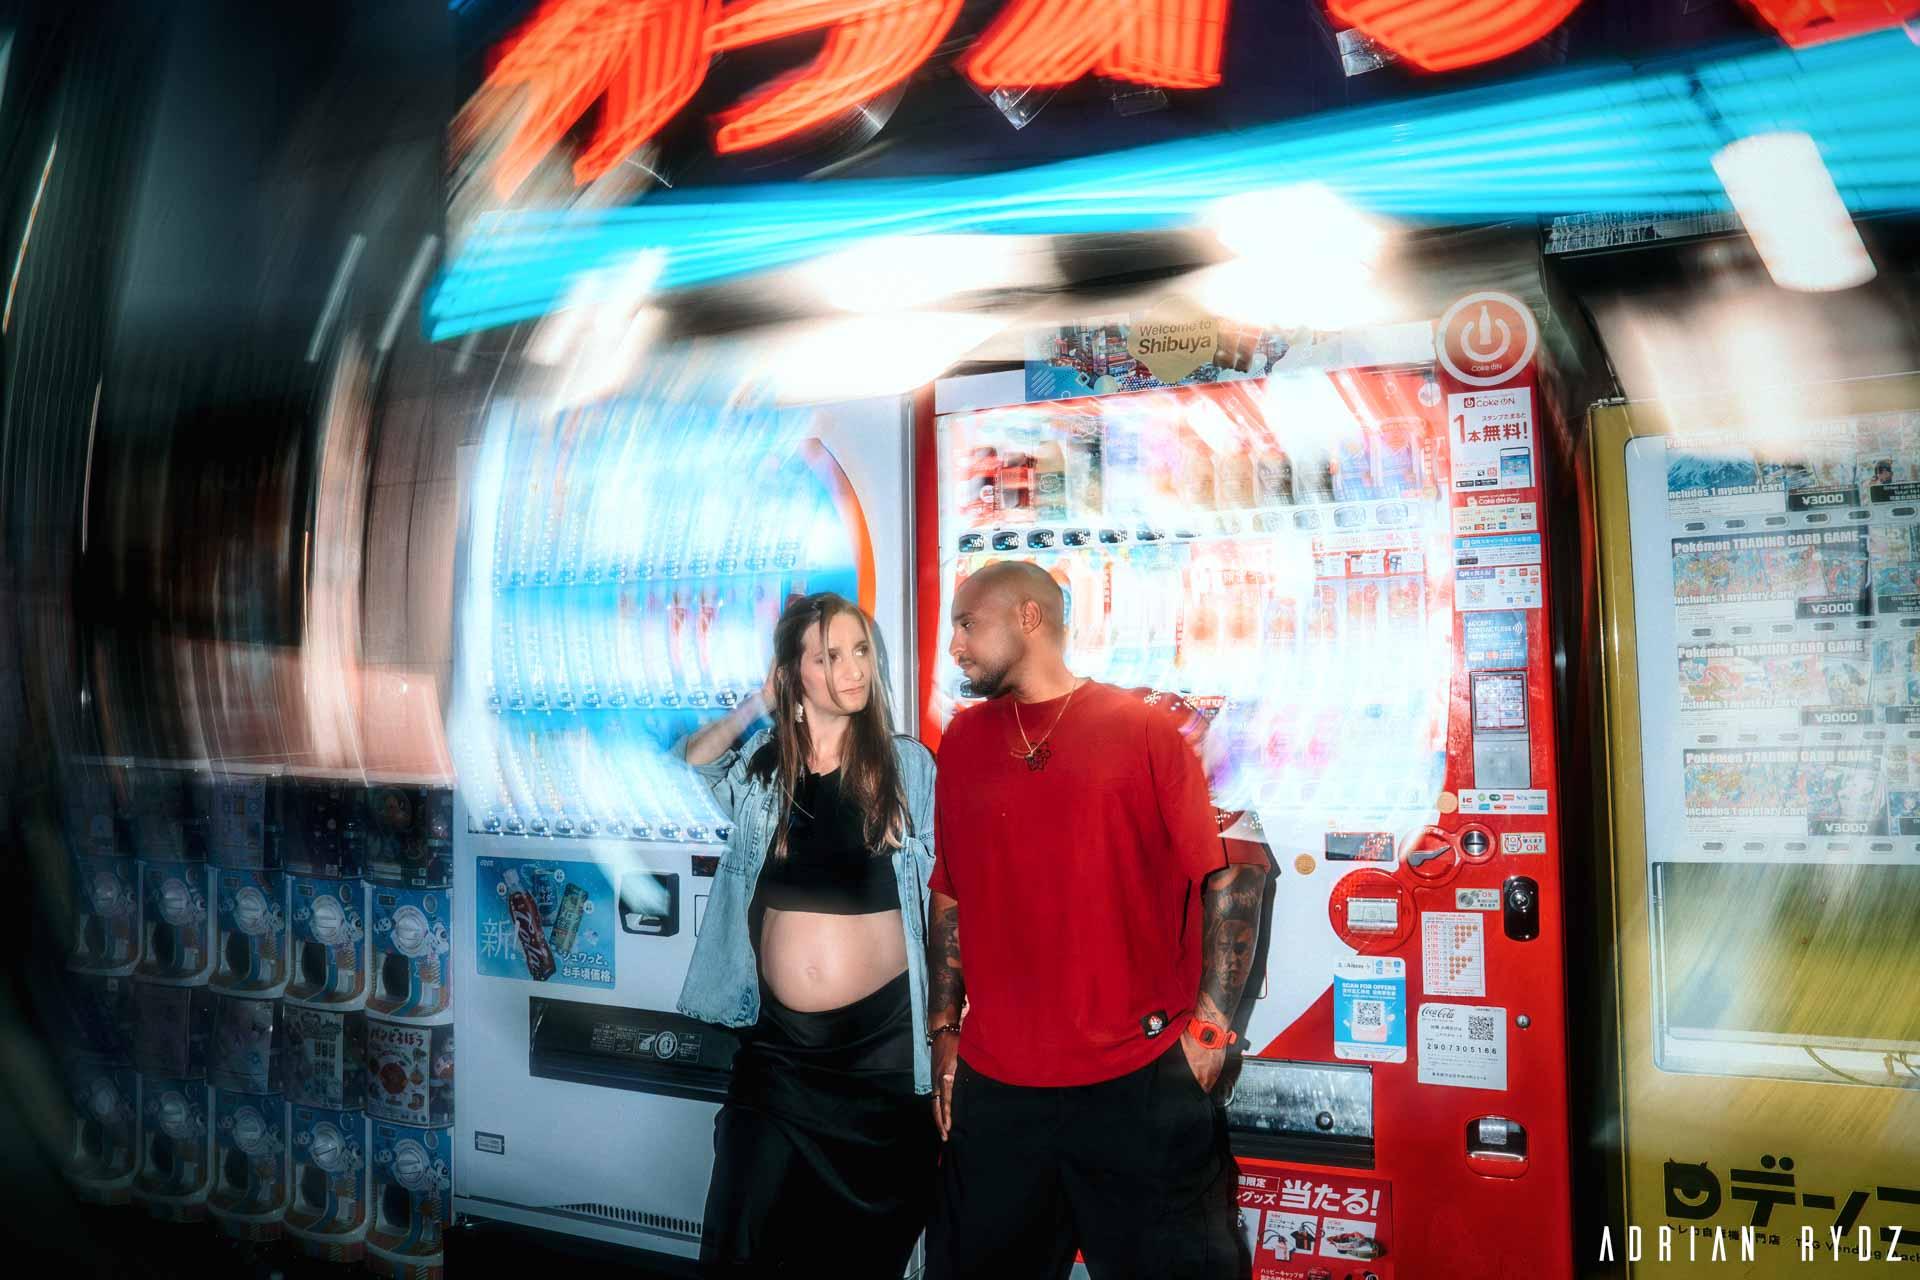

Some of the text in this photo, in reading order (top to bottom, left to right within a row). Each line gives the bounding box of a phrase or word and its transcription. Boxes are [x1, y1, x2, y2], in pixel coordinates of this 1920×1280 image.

[1139, 320, 1212, 337] Welcome to
[1137, 335, 1212, 355] Shibuya
[1476, 399, 1499, 408] Coke
[1668, 487, 1709, 499] ncludes
[1711, 486, 1716, 496] 1
[1717, 484, 1759, 496] mystery
[1801, 494, 1844, 505] ¥3000
[1674, 531, 1859, 554] Pokémon TRADING CARD GAME
[1811, 602, 1854, 614] ¥3000
[1678, 639, 1863, 658] Pokémon TRADING CARD GAME
[1815, 712, 1857, 723] ¥3000
[1686, 749, 1873, 764] Pokémon TRADING CARD GAME
[1825, 823, 1868, 833] ¥3000
[1236, 1191, 1277, 1205] グッズ
[1280, 1179, 1381, 1217] 当たる!
